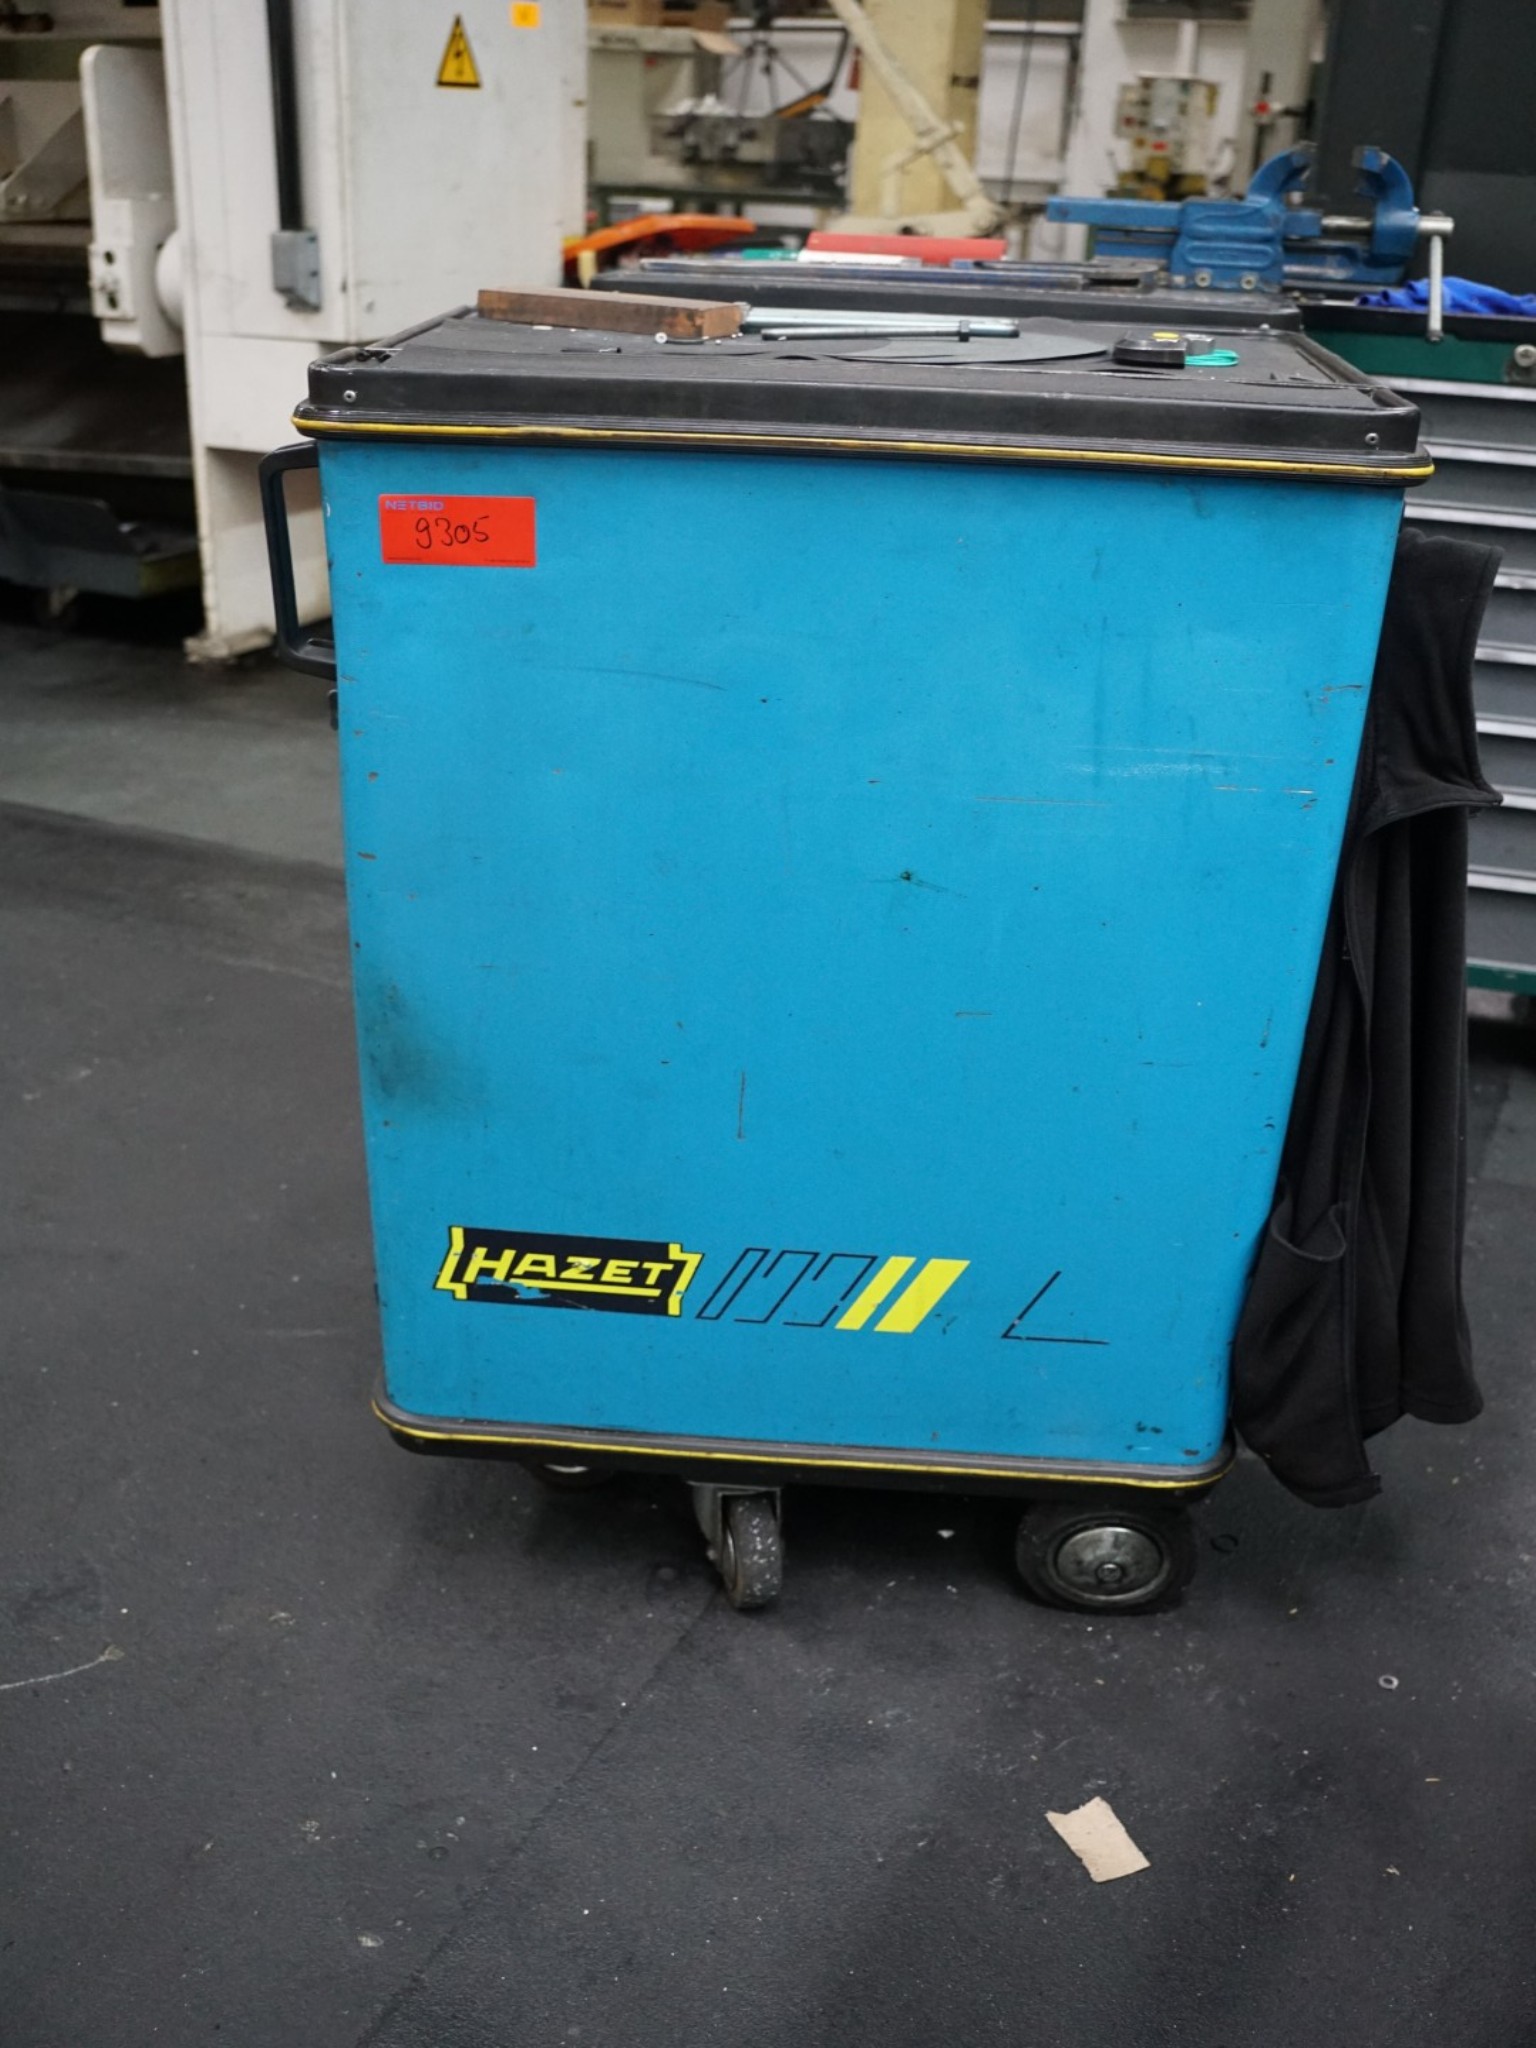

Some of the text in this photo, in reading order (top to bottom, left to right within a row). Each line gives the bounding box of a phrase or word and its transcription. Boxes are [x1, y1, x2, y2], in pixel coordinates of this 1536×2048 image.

[385, 499, 444, 511] NETBID
[415, 515, 490, 549] 9305
[462, 1246, 674, 1286] HAZET
